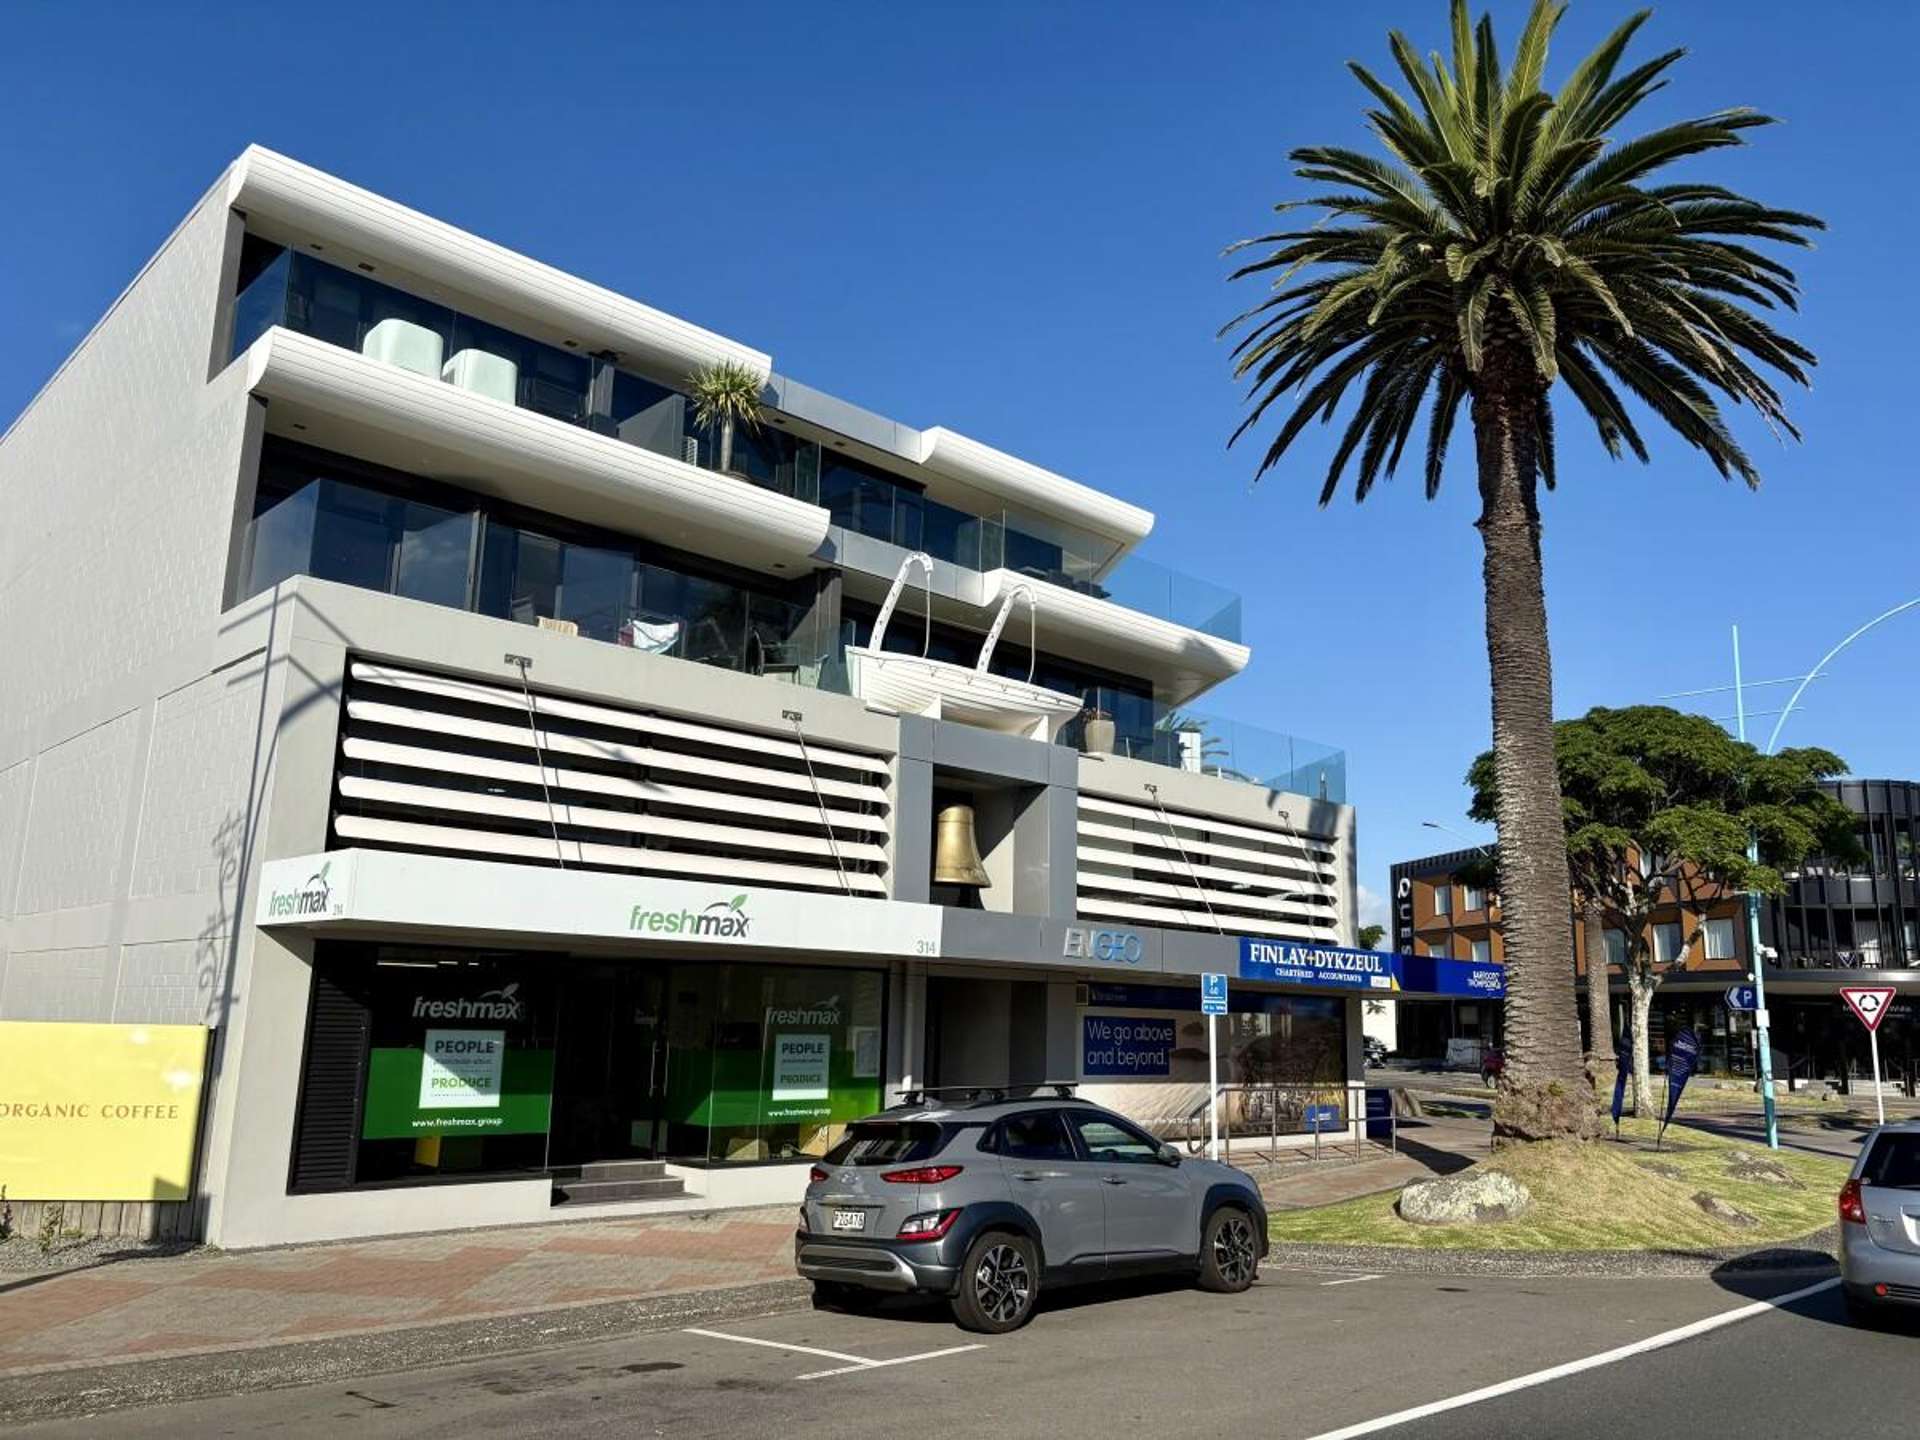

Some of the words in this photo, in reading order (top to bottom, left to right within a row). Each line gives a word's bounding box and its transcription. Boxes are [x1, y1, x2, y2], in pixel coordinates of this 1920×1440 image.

[269, 889, 329, 916] freshmax
[630, 905, 749, 938] freshmax
[1398, 878, 1413, 955] QUES
[916, 940, 935, 954] 314
[1210, 975, 1218, 986] P
[1743, 990, 1753, 1007] P
[412, 996, 520, 1019] freshmax
[767, 1006, 841, 1025] freshmax
[1087, 1021, 1111, 1040] We
[1113, 1026, 1132, 1046] go
[1134, 1024, 1174, 1041] above
[434, 1040, 495, 1054] PEOPLE
[782, 1042, 824, 1055] PEOPLE
[1087, 1048, 1115, 1065] and
[1117, 1047, 1168, 1071] beyond.
[431, 1077, 492, 1089] PRODUCE
[779, 1074, 821, 1085] PRODUCE
[0, 1103, 90, 1118] ORGANIC
[101, 1104, 179, 1120] COFFEE
[411, 1117, 504, 1128] www.freshmax.group
